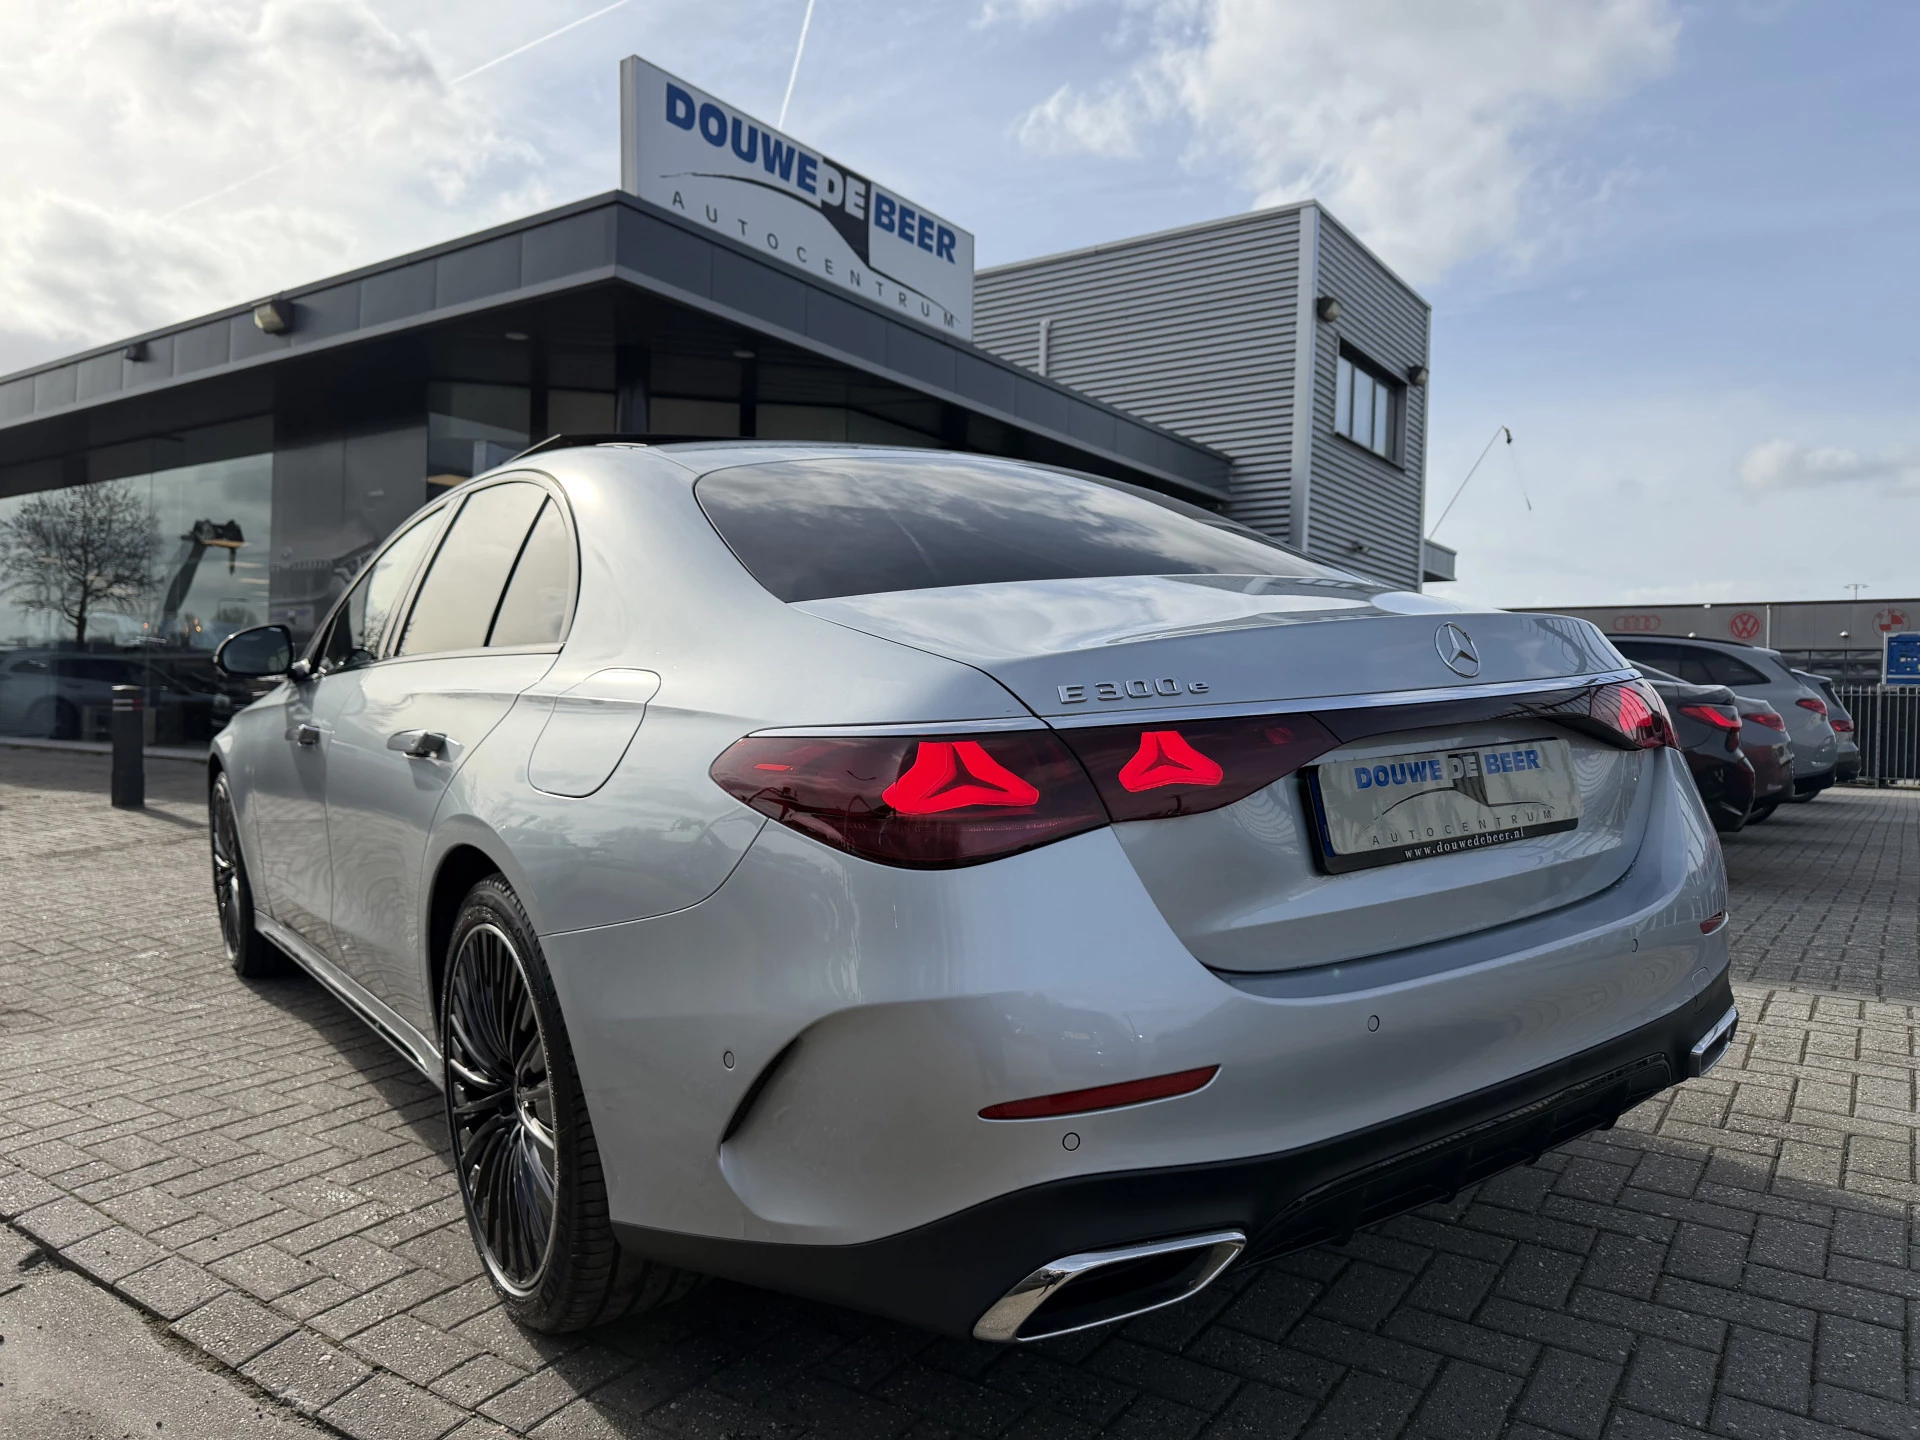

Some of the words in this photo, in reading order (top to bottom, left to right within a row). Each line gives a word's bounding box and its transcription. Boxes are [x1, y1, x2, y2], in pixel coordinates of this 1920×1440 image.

[665, 81, 818, 196] DOUWE
[820, 160, 867, 221] DE
[873, 191, 957, 265] BEER
[671, 190, 956, 329] AUTOCENTRUM
[1057, 684, 1087, 704] E
[1095, 677, 1183, 701] 300
[1188, 680, 1210, 694] e
[1354, 759, 1443, 789] DOUWE
[1450, 756, 1479, 780] DE
[1483, 749, 1542, 775] BEER
[1371, 810, 1553, 846] AUTOCENTRUM
[1403, 826, 1525, 860] www.douwedebeer.nl
